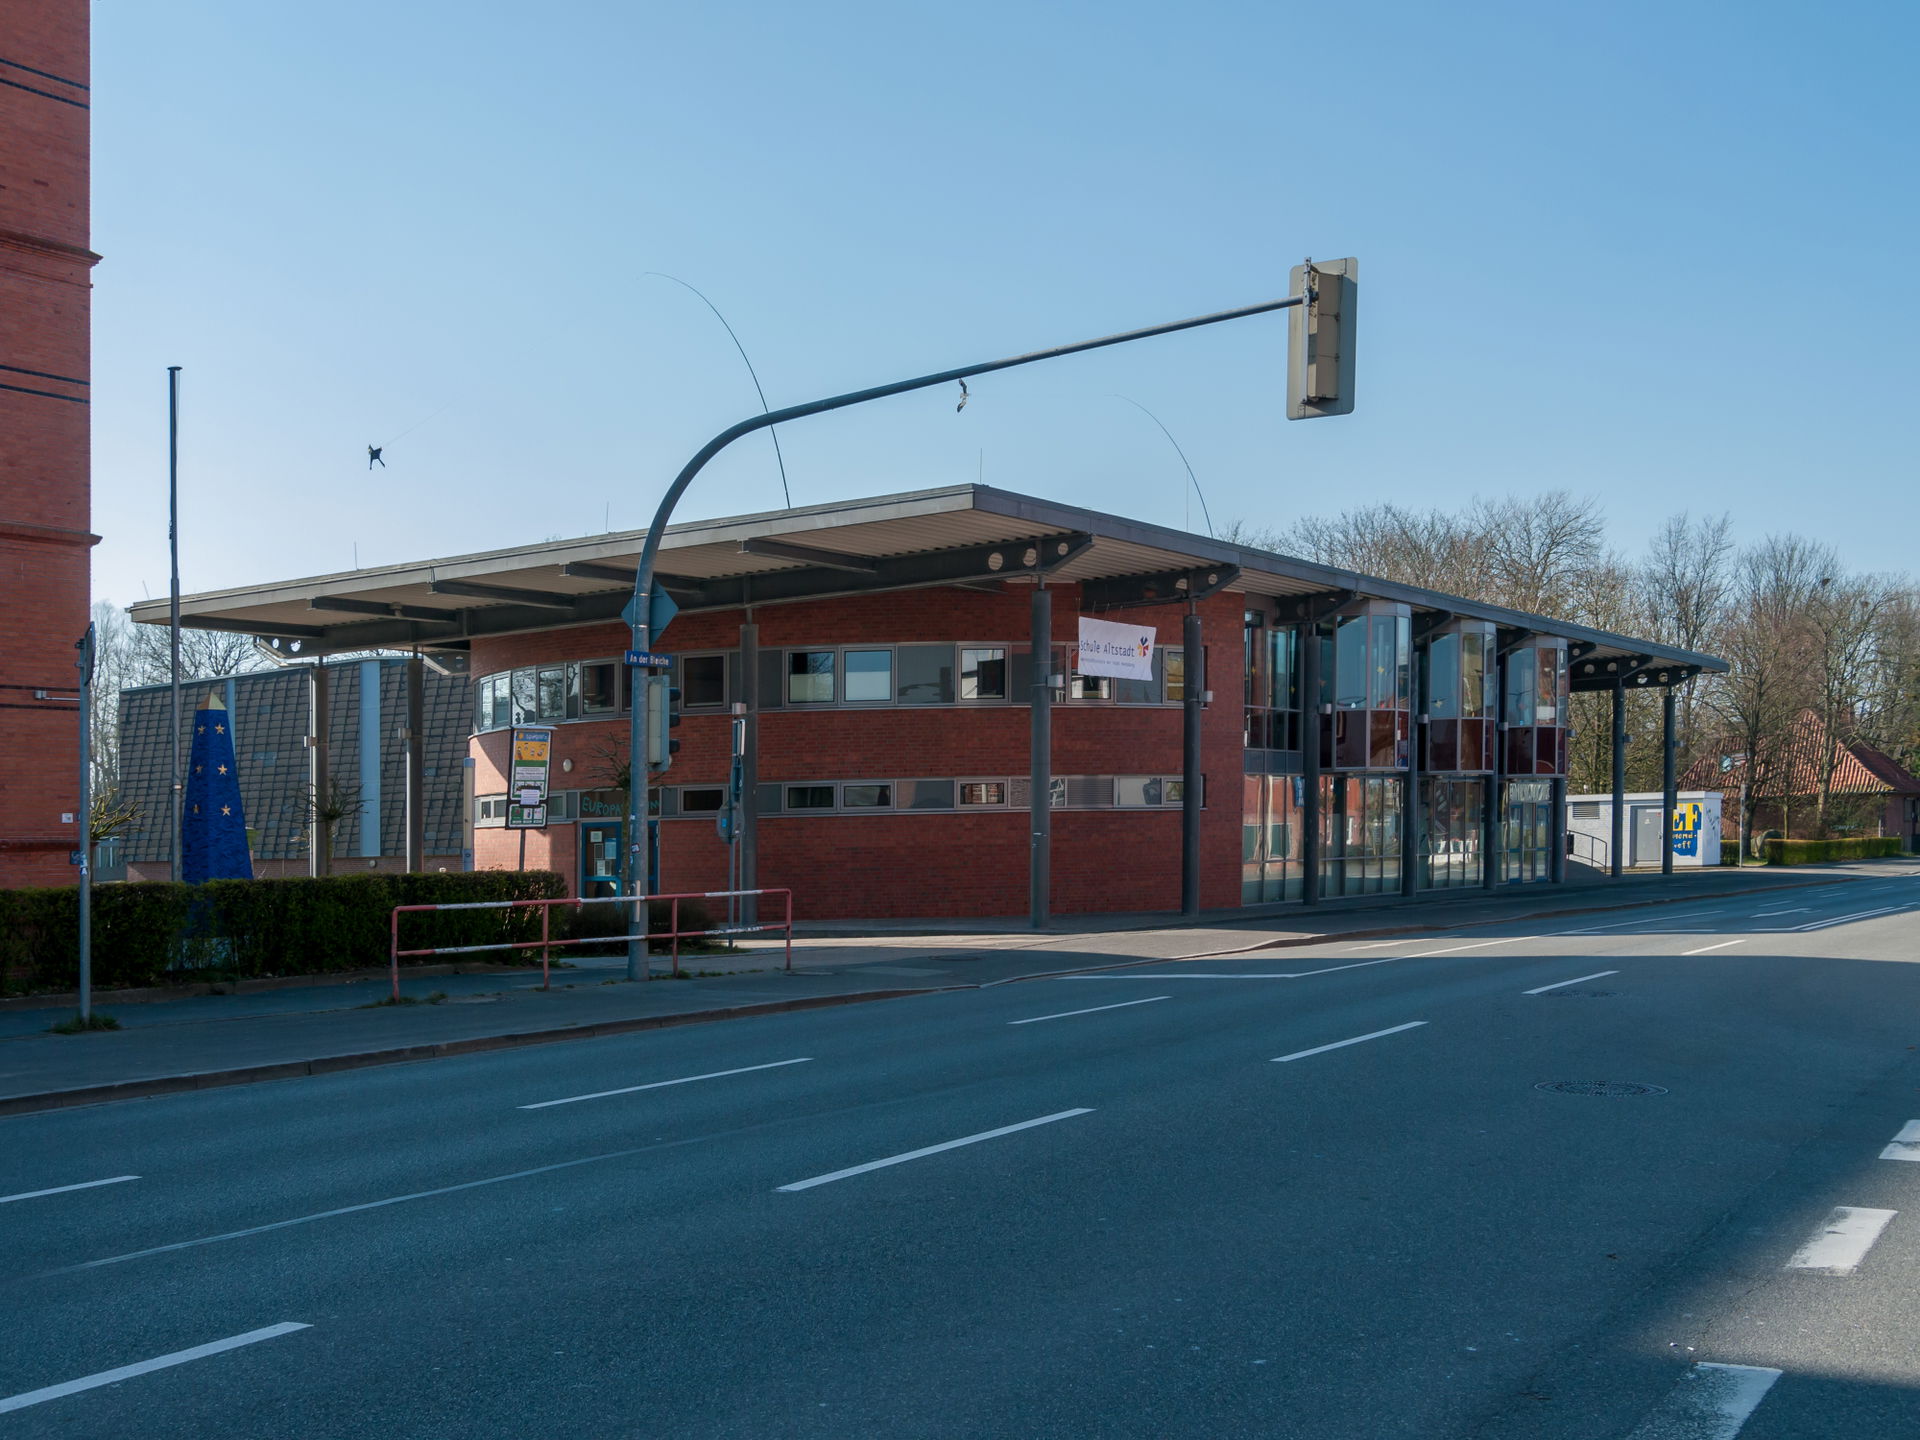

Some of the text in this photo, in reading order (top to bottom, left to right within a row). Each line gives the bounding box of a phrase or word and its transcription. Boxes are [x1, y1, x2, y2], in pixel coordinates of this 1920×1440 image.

[1080, 639, 1135, 657] Schule Altstadt
[629, 653, 637, 663] An
[638, 654, 648, 664] der
